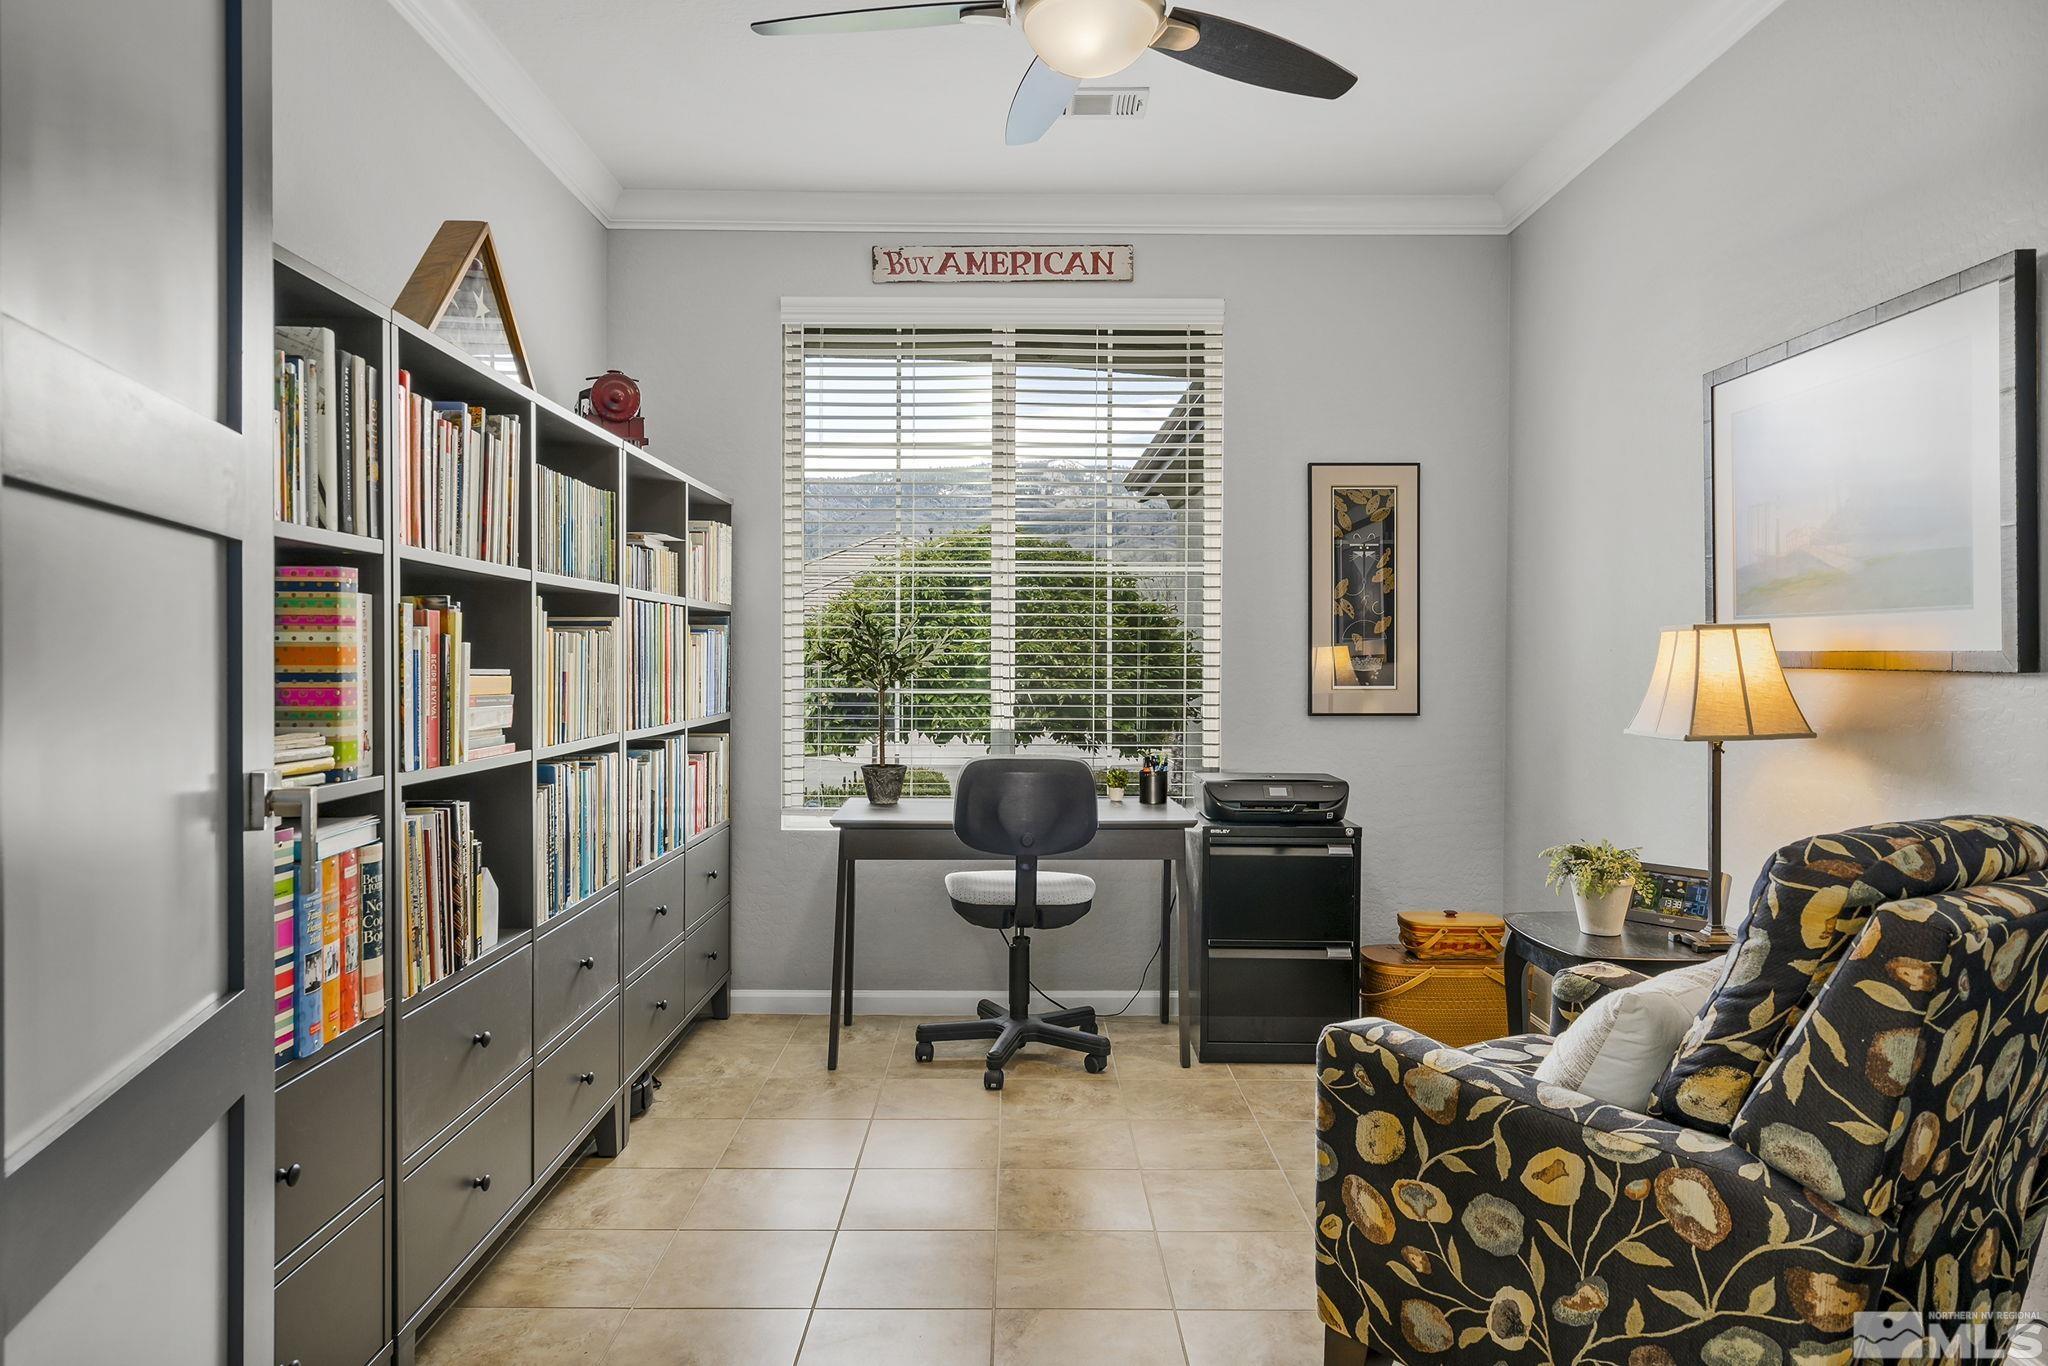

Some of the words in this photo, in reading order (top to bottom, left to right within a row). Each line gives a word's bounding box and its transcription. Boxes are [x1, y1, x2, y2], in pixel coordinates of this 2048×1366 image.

[934, 251, 1115, 276] AMERICAN
[430, 653, 438, 682] RECIPE
[430, 685, 438, 721] REVIVAL
